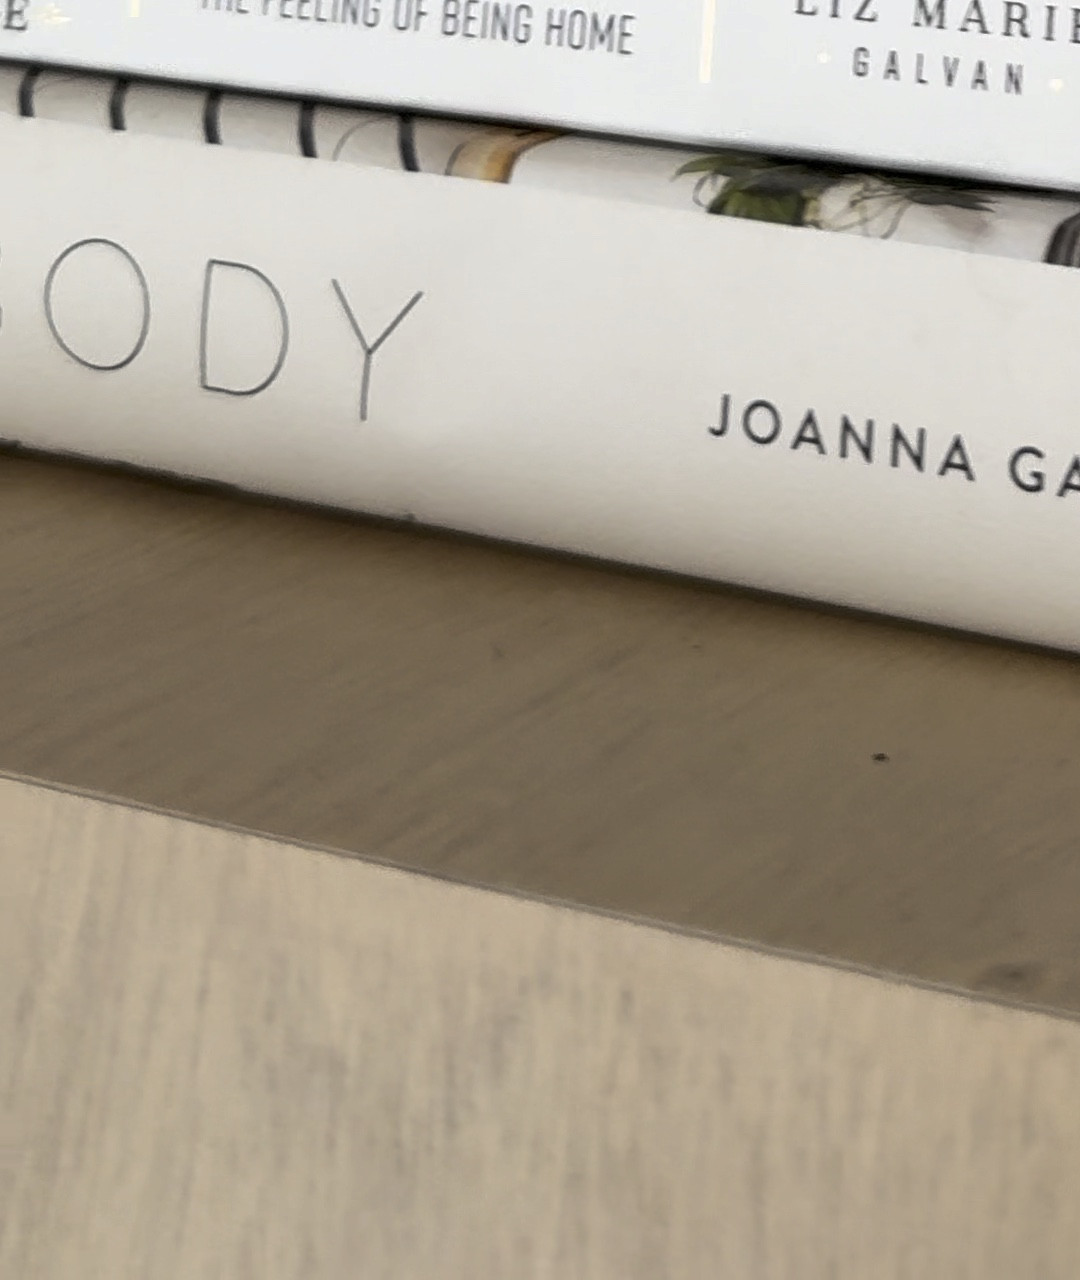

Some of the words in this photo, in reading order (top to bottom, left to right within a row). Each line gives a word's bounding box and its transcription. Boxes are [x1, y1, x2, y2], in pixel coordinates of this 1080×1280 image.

[545, 9, 635, 55] HOME
[853, 47, 1022, 94] GALVAN
[0, 238, 424, 421] ODY
[708, 394, 975, 481] JOANNA
